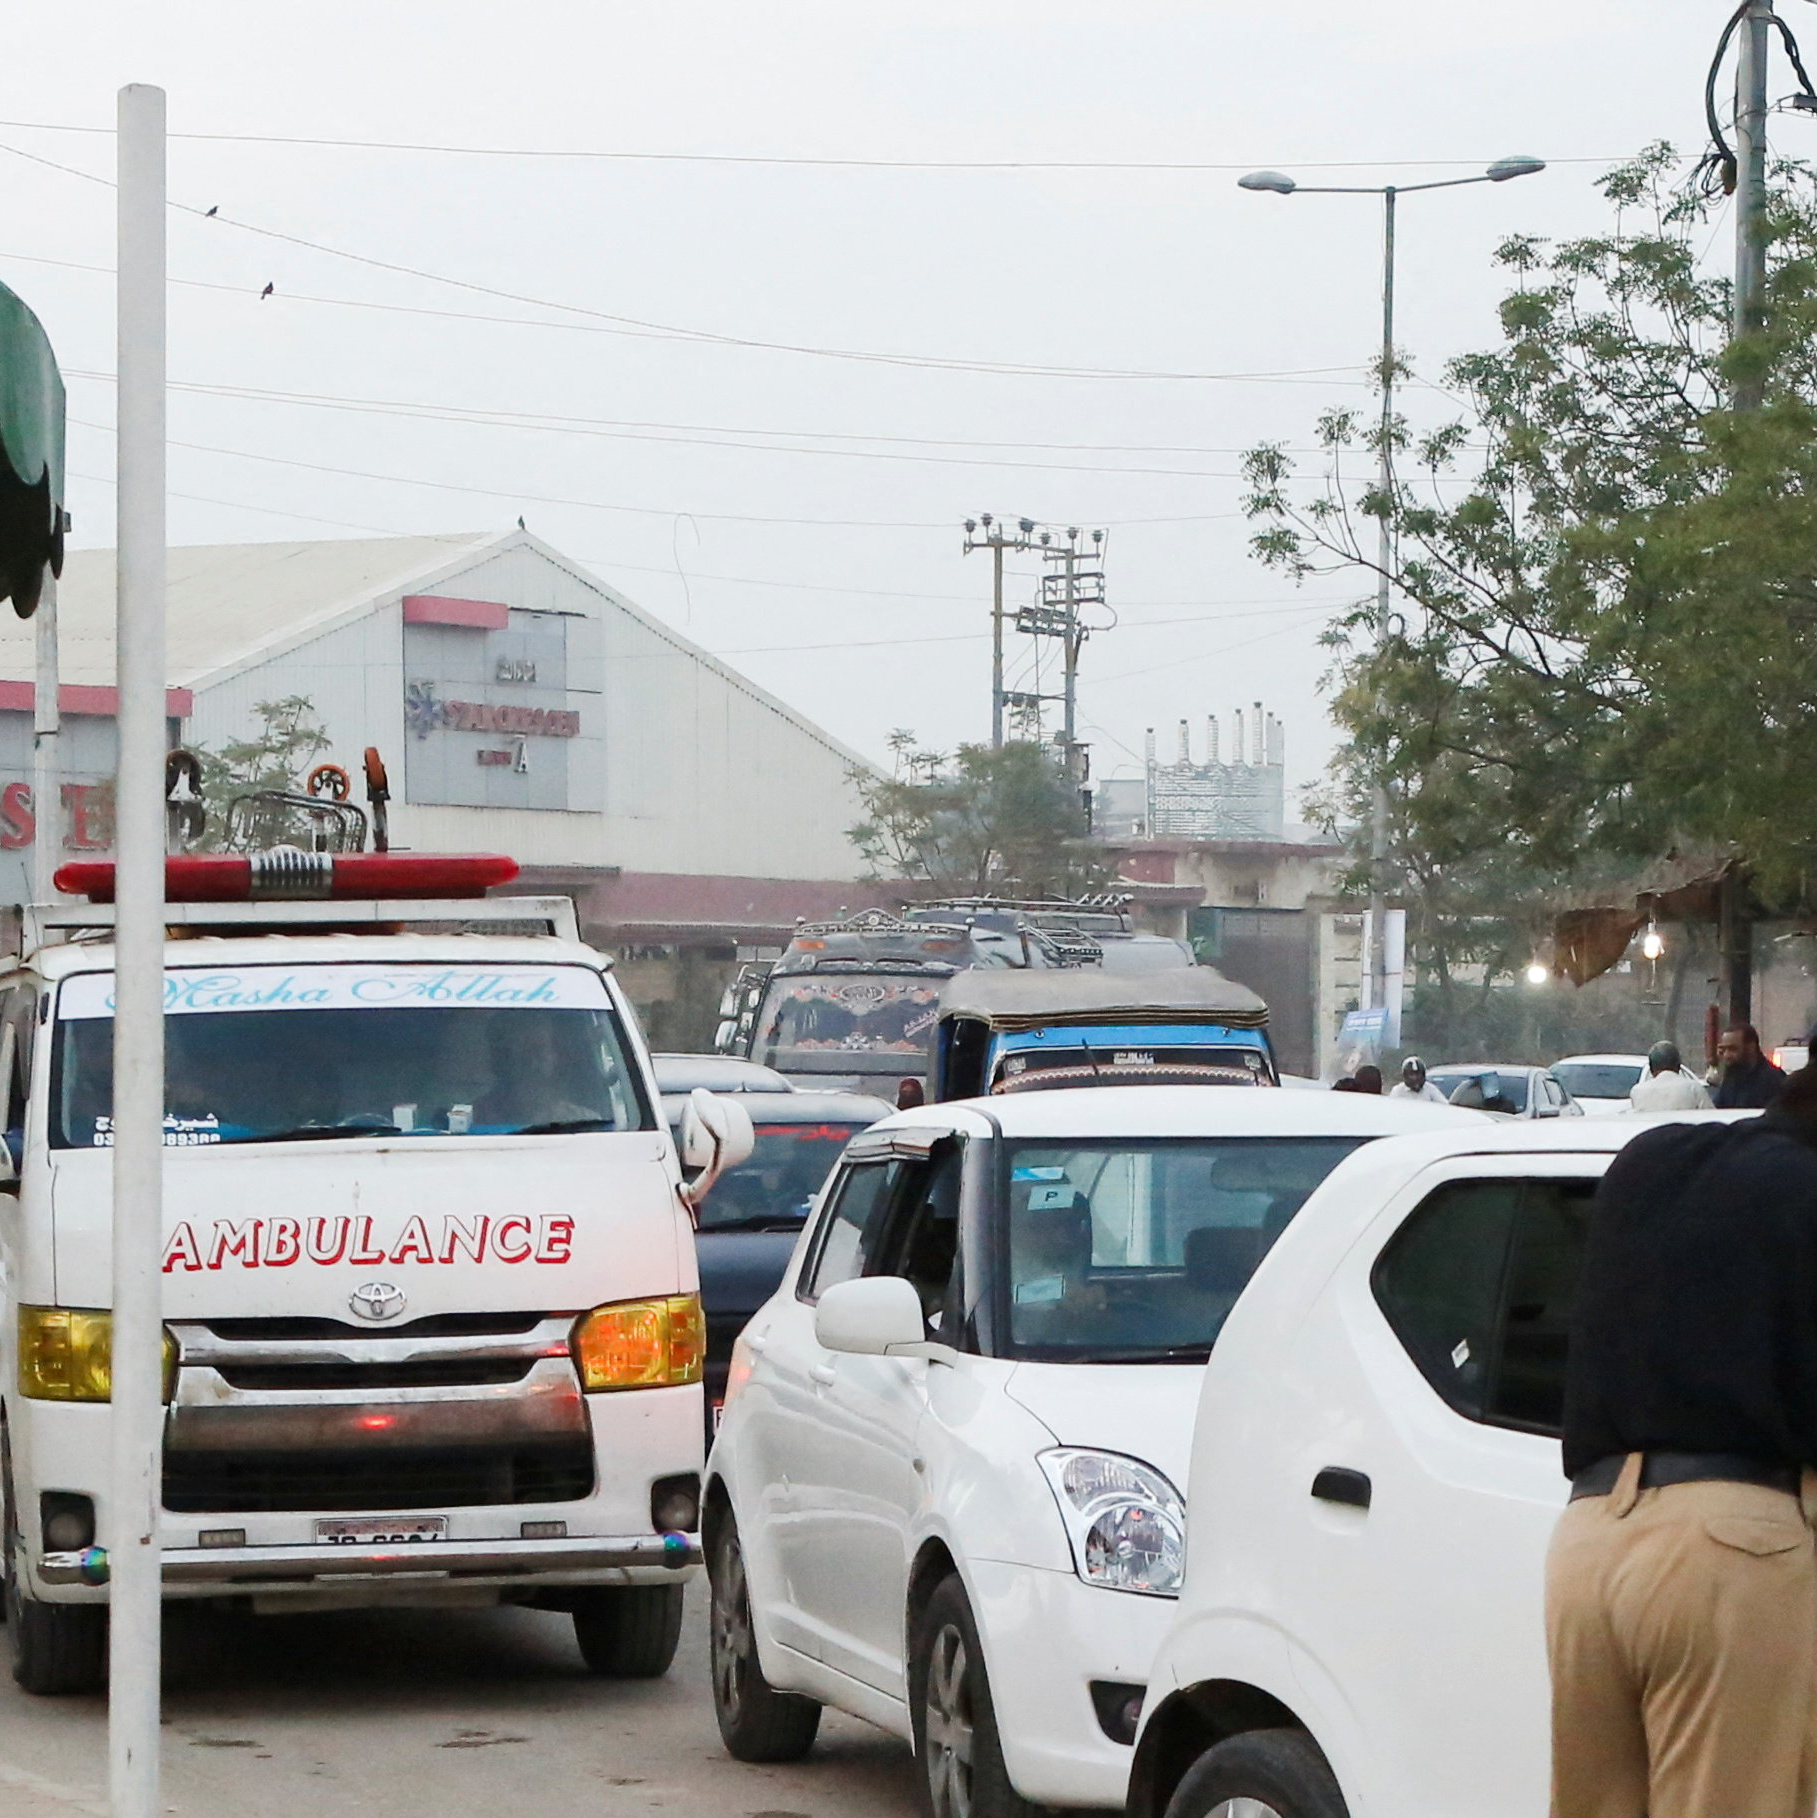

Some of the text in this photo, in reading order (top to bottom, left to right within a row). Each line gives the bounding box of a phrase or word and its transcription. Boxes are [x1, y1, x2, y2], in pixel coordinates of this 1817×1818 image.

[351, 970, 560, 1004] Allah
[1045, 1190, 1059, 1203] P
[161, 1213, 576, 1273] AMBULANCE
